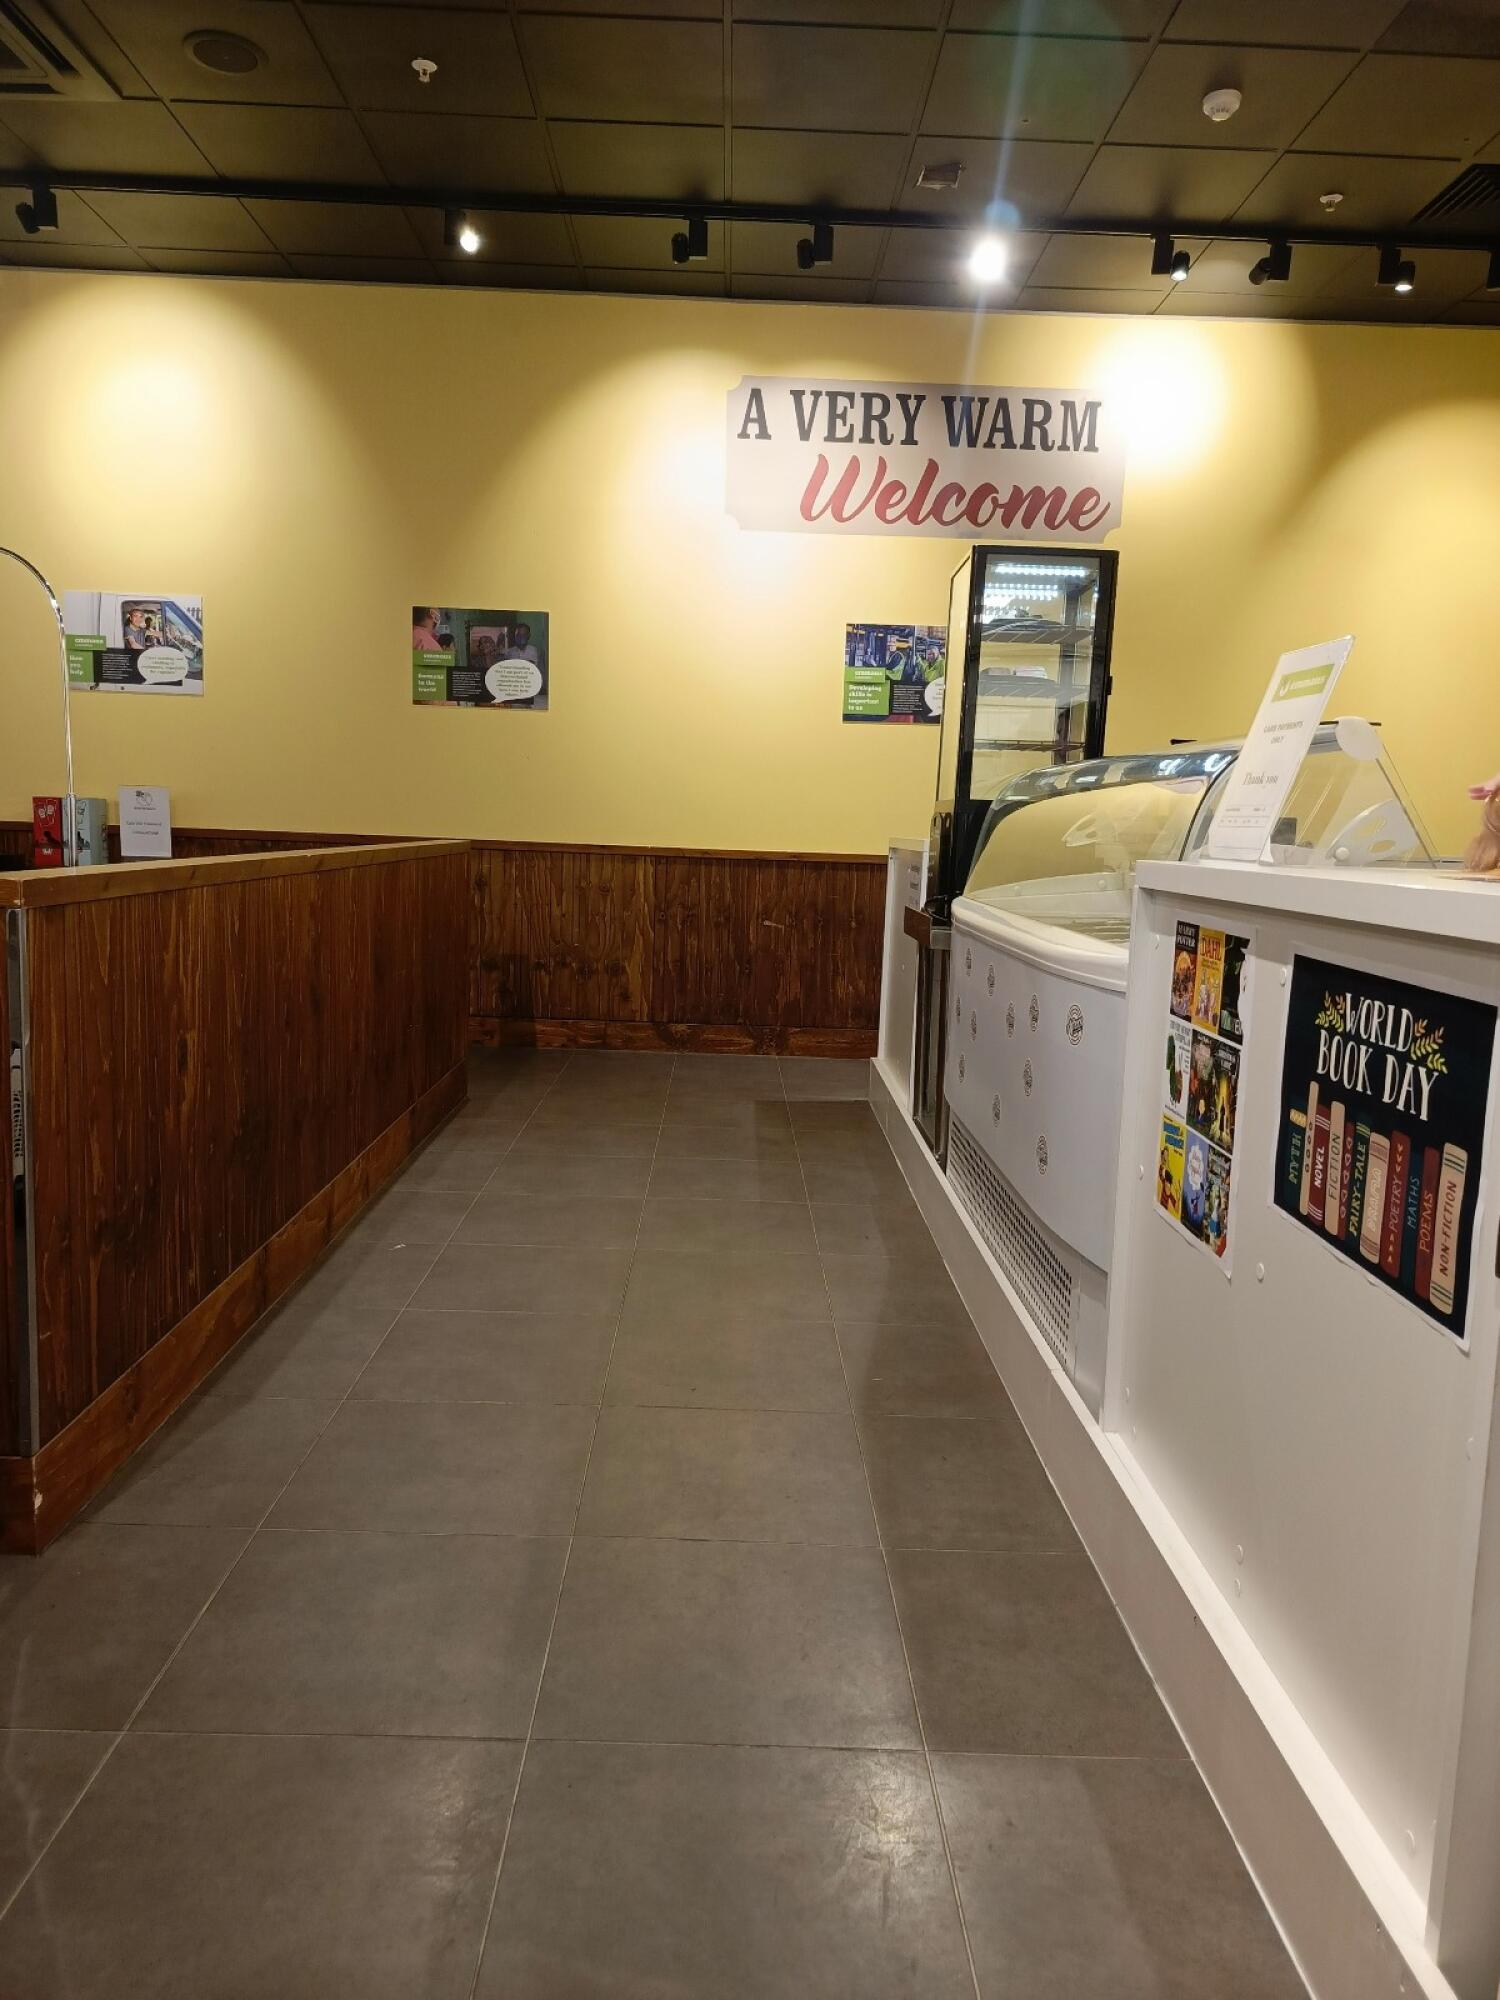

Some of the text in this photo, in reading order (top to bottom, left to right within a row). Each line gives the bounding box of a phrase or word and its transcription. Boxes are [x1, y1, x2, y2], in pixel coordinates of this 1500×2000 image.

[737, 387, 1102, 452] A VERY WARM
[800, 453, 1111, 532] Welcome
[1200, 936, 1222, 961] DAHL
[1345, 992, 1414, 1052] WORLD
[1316, 1029, 1440, 1122] BOOK DAY
[1314, 1145, 1325, 1188] NOVEL
[1328, 1132, 1341, 1201] FICTION
[1349, 1141, 1367, 1237] FAIRY-TALE
[1388, 1174, 1403, 1233] POETRY
[1406, 1175, 1420, 1229] MATHS
[1420, 1190, 1434, 1253] POEMS
[1439, 1180, 1457, 1277] NON-FICTION
